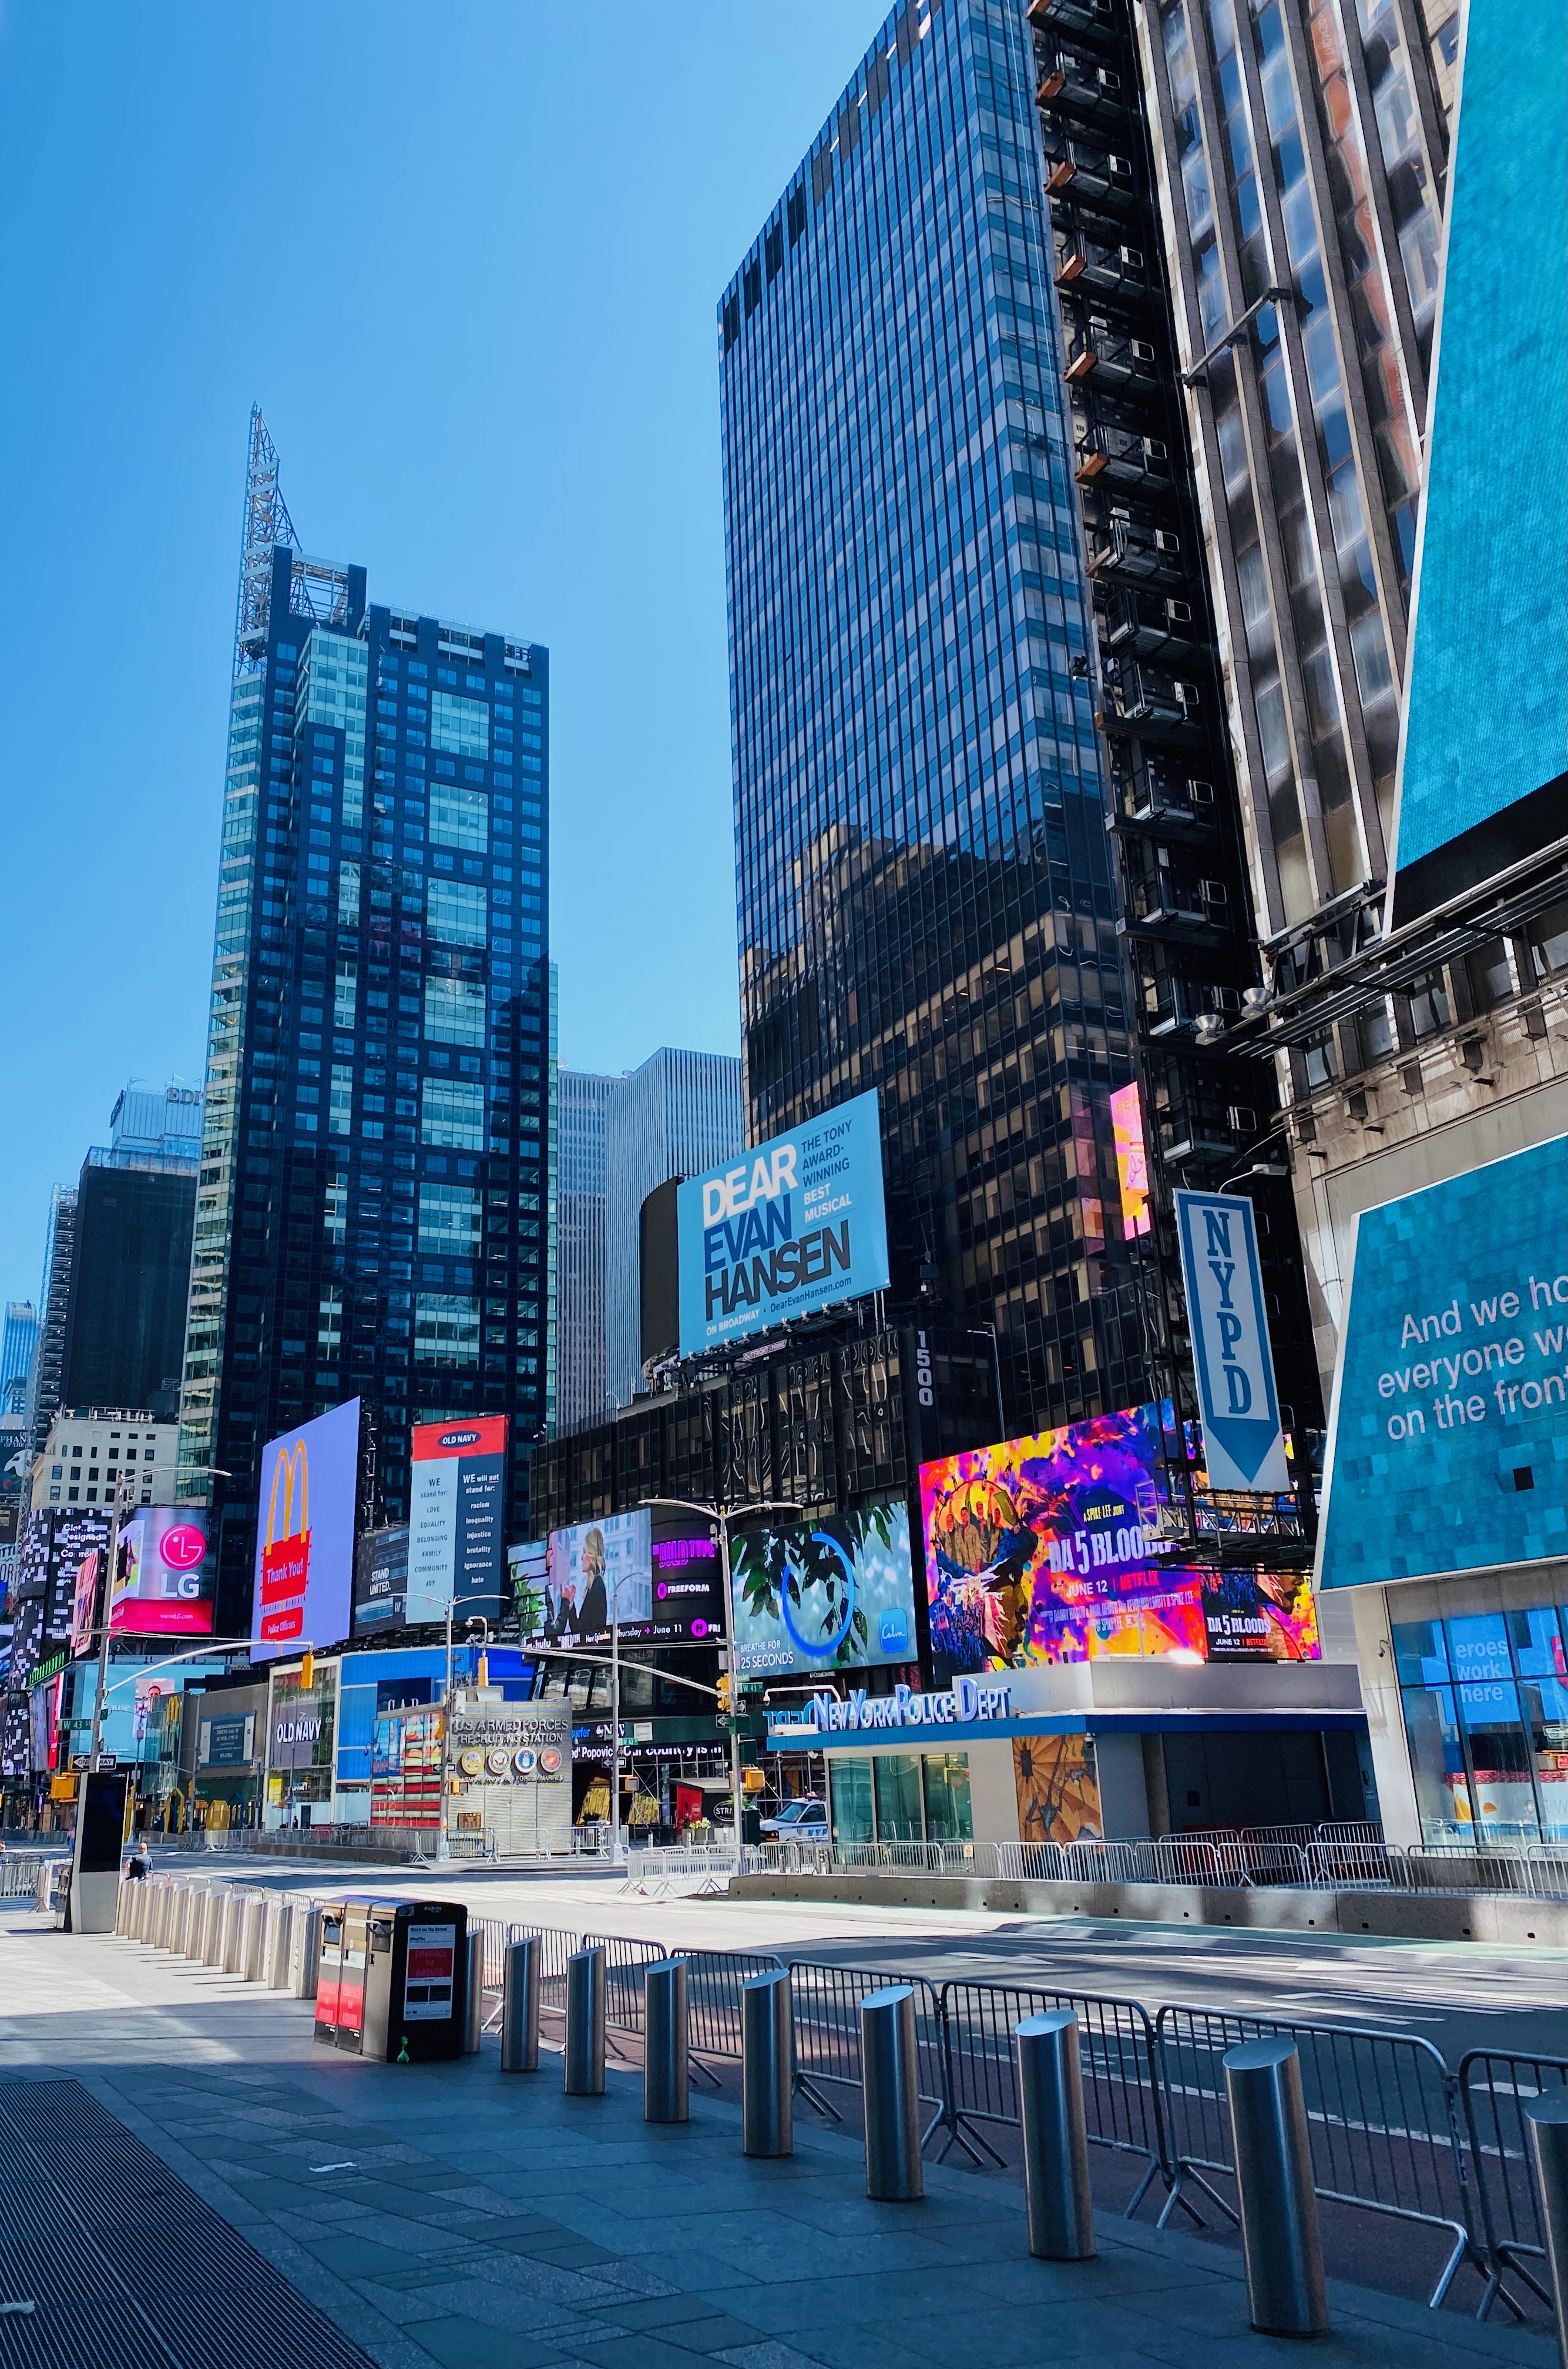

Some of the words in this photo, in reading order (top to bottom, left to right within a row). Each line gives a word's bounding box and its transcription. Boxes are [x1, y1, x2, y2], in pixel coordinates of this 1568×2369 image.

[802, 1136, 822, 1155] THE
[823, 1119, 852, 1145] TONY
[803, 1146, 845, 1171] AWARD-
[803, 1157, 850, 1188] WINNING
[701, 1143, 799, 1229] DEAR
[804, 1183, 831, 1206] BEST
[804, 1193, 852, 1223] MUSICAL
[704, 1193, 793, 1275] EVAN
[705, 1219, 851, 1322] HANSEN
[706, 1325, 717, 1337] ON
[718, 1308, 760, 1332] BROADWAY
[770, 1276, 852, 1314] DearEvanHansen.com
[1203, 1210, 1252, 1414] NYPD
[1401, 1299, 1462, 1349] And
[1470, 1291, 1520, 1326] we
[744, 1345, 770, 1360] OUTFRONT
[771, 1340, 786, 1351] PRIME
[917, 1330, 933, 1406] 1500
[1378, 1338, 1525, 1398] everyone
[1388, 1409, 1426, 1441] on
[1432, 1393, 1486, 1430] the
[442, 1435, 456, 1445] OLD
[457, 1433, 478, 1444] NAVY
[429, 1478, 441, 1488] WE
[463, 1474, 476, 1484] WE
[477, 1474, 488, 1482] will
[420, 1490, 437, 1499] stand
[466, 1485, 482, 1494] stand
[483, 1484, 495, 1493] for:
[466, 1515, 494, 1525] inequality
[1087, 1507, 1101, 1521] SPIKE
[1102, 1504, 1111, 1519] LEE
[420, 1520, 446, 1528] EQUALITY
[417, 1535, 448, 1543] BELONGING
[466, 1531, 492, 1540] injustice
[466, 1545, 491, 1555] brutality
[659, 1540, 689, 1569] BOLD
[689, 1539, 715, 1558] TYPE
[1048, 1539, 1075, 1573] DA
[1075, 1530, 1090, 1575] 5
[267, 1564, 288, 1585] Thank
[288, 1558, 304, 1578] You!
[415, 1564, 448, 1573] COMMUNITY
[464, 1561, 492, 1570] ignorance
[371, 1567, 390, 1582] STAND
[160, 1573, 200, 1599] LG
[370, 1580, 391, 1596] UNITED.
[667, 1583, 710, 1593] FREEFORM
[1066, 1582, 1093, 1598] JUNE
[1096, 1579, 1108, 1593] 12
[1120, 1570, 1159, 1592] NETFLIX
[268, 1623, 279, 1635] Police
[280, 1620, 296, 1632] Officers
[653, 1625, 671, 1635] June
[674, 1624, 682, 1632] 11
[882, 1624, 906, 1639] Calm
[1207, 1616, 1223, 1633] DA
[1222, 1615, 1231, 1635] 5
[1230, 1617, 1272, 1633] BLOODS
[740, 1643, 766, 1653] BREATHE
[768, 1640, 781, 1649] FOR
[740, 1657, 751, 1669] 25
[751, 1652, 794, 1668] SECONDS
[1458, 1659, 1503, 1681] work
[1460, 1683, 1504, 1703] here
[814, 1692, 851, 1732] NEW
[849, 1689, 893, 1729] YORK
[895, 1684, 955, 1726] POLICE
[959, 1678, 1011, 1722] DEPT
[63, 1721, 71, 1729] W
[73, 1721, 82, 1729] 43
[277, 1722, 294, 1743] OLD
[296, 1719, 322, 1742] NAVY
[477, 1719, 522, 1731] ARMED
[522, 1718, 569, 1730] FORCES
[522, 1733, 563, 1743] STATION
[415, 1949, 447, 1959] EMBRACE
[415, 1968, 444, 1977] ABSURD
